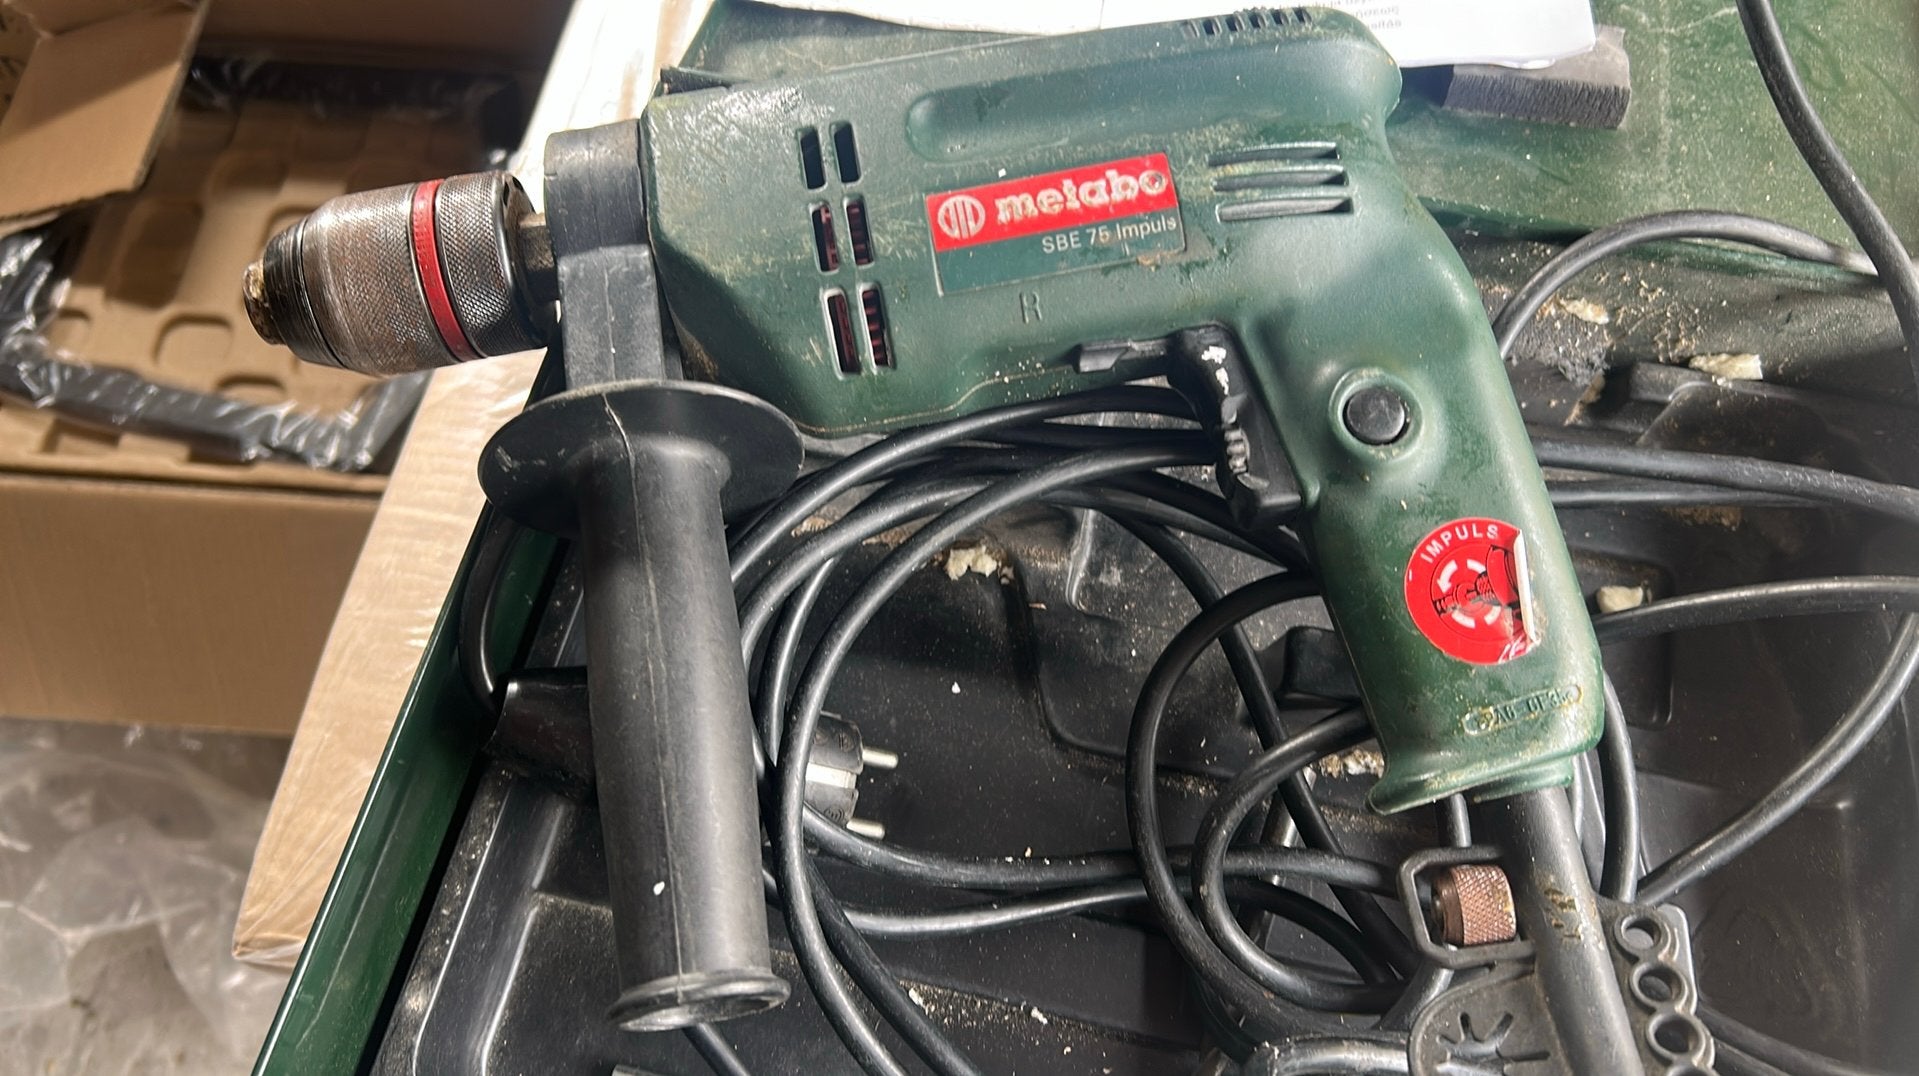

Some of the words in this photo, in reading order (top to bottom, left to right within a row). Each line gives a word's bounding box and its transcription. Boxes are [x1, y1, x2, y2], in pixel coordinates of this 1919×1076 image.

[995, 168, 1168, 225] metabo
[1041, 230, 1082, 254] SBE
[1086, 226, 1110, 245] 75
[1116, 215, 1177, 241] Impuls
[1018, 291, 1042, 324] R
[1420, 522, 1499, 564] IMPULS
